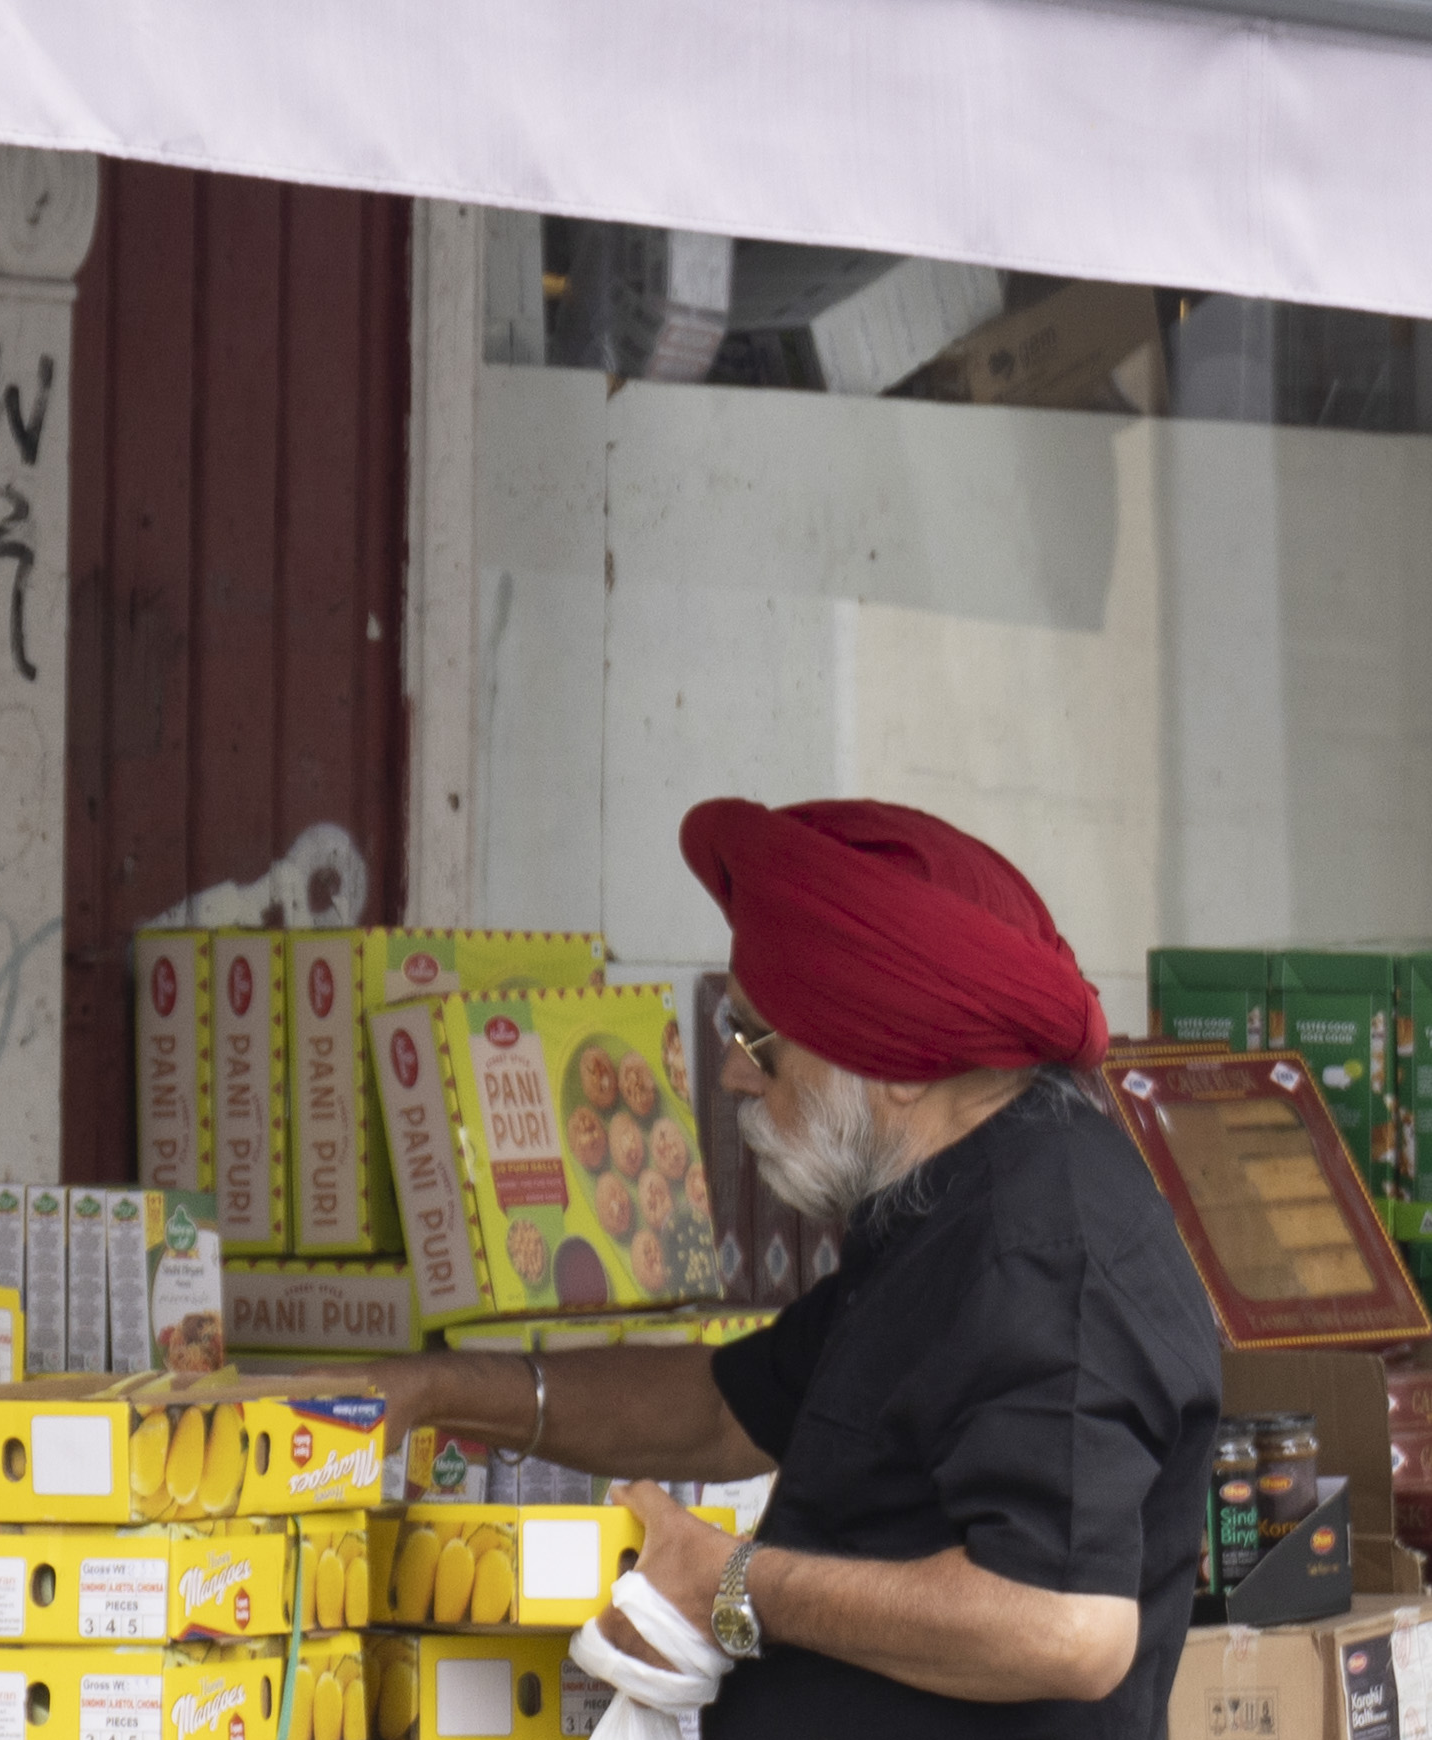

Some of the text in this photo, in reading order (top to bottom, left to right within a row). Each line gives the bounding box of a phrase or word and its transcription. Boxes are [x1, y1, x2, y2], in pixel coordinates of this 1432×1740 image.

[151, 1035, 176, 1119] PANI
[484, 1070, 542, 1107] PANI
[226, 1035, 251, 1226] PANI PURI
[309, 1035, 338, 1227] PANI PURI
[492, 1110, 550, 1149] PURI
[401, 1106, 456, 1298] PANI PURI
[233, 1297, 396, 1336] PANI PURI
[82, 1564, 107, 1575] Gross
[105, 1601, 138, 1612] PIECES
[85, 1618, 137, 1635] 3 4 5
